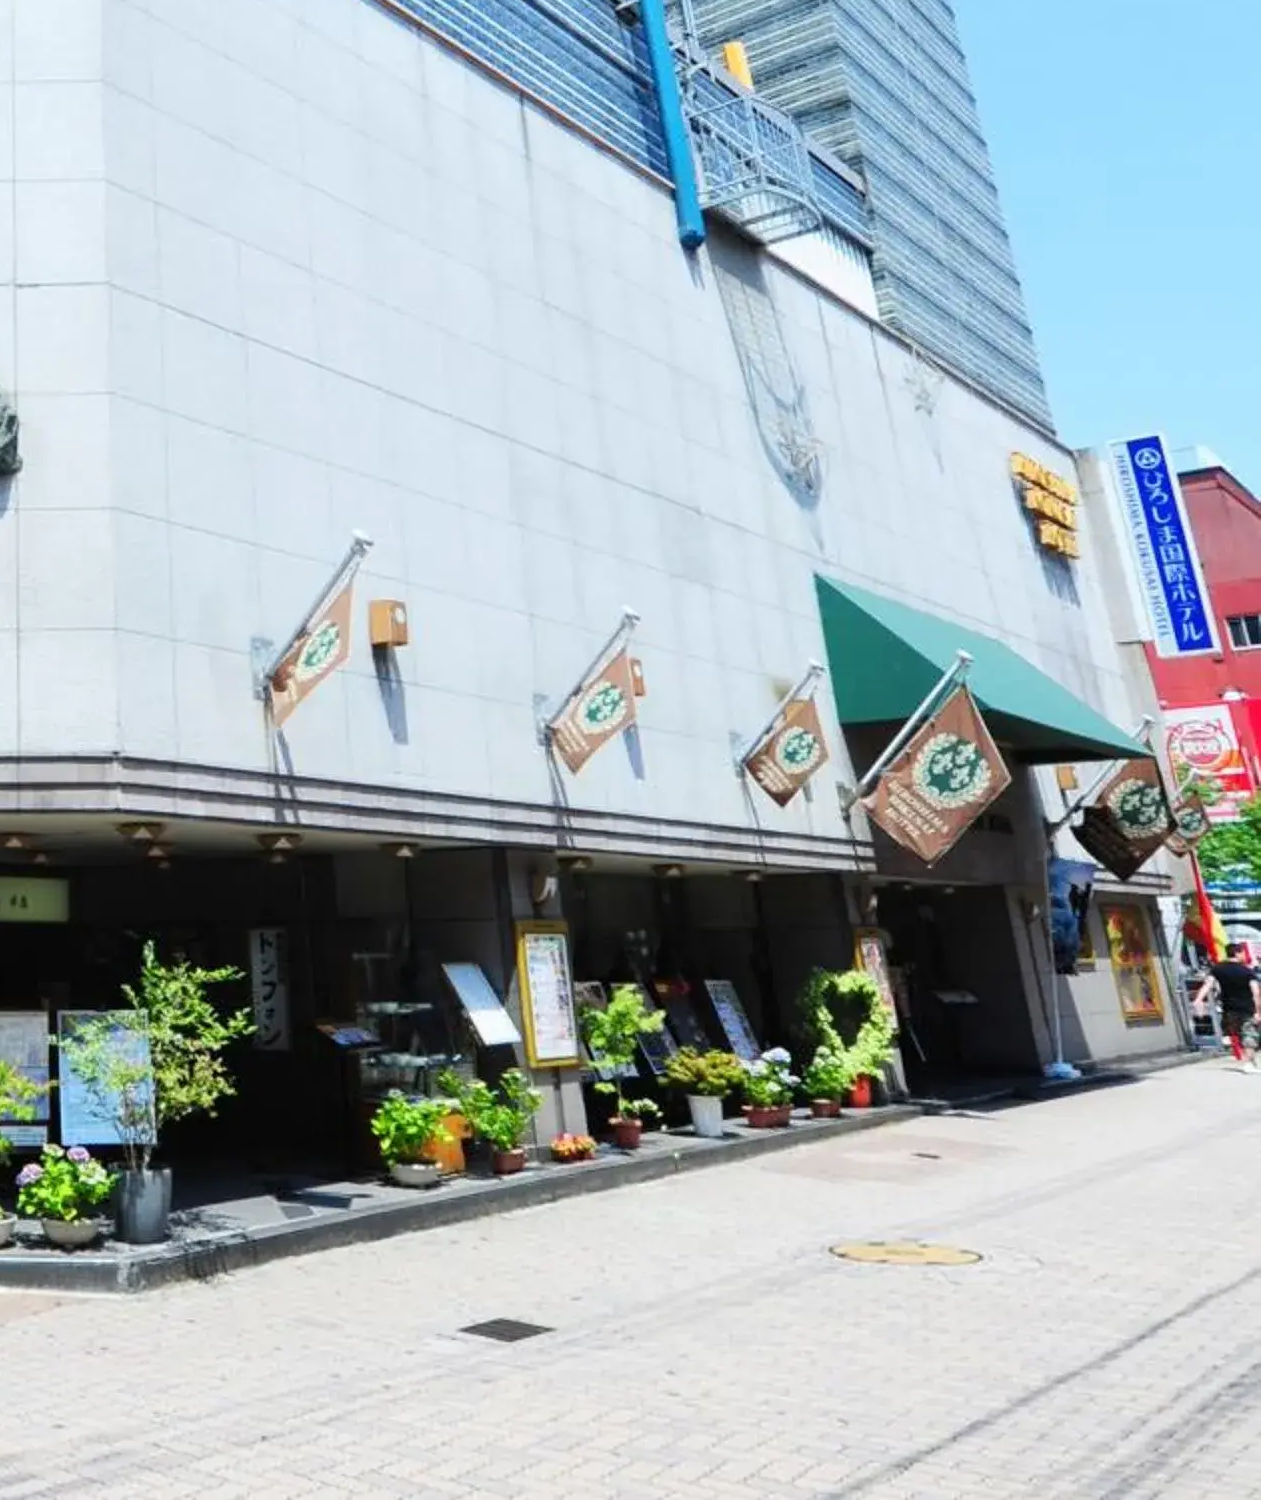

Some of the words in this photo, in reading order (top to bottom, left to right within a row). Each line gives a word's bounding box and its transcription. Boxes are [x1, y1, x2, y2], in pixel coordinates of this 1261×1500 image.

[1140, 470, 1204, 642] ひろしま国際ホテル
